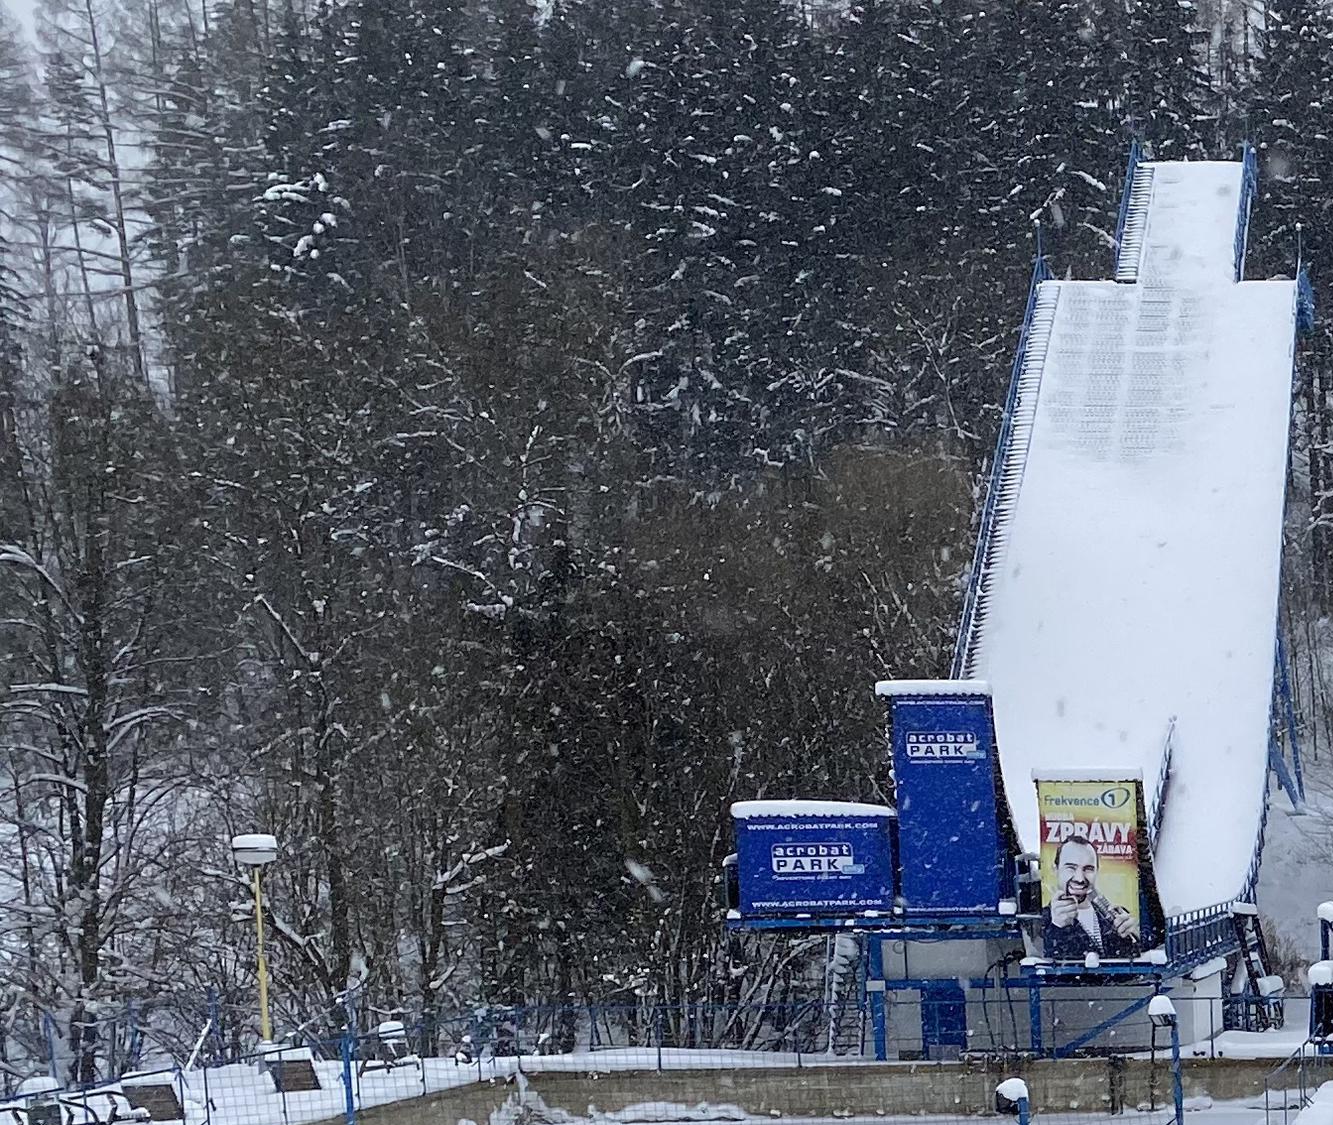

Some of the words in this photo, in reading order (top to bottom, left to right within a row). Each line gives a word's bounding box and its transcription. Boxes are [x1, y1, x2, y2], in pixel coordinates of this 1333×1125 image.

[909, 733, 973, 743] acrobat
[911, 746, 963, 755] PARK
[1044, 795, 1099, 806] Frekvence
[1046, 817, 1131, 843] ZPRÁVY
[775, 845, 849, 856] acrobat
[777, 859, 839, 870] PARK
